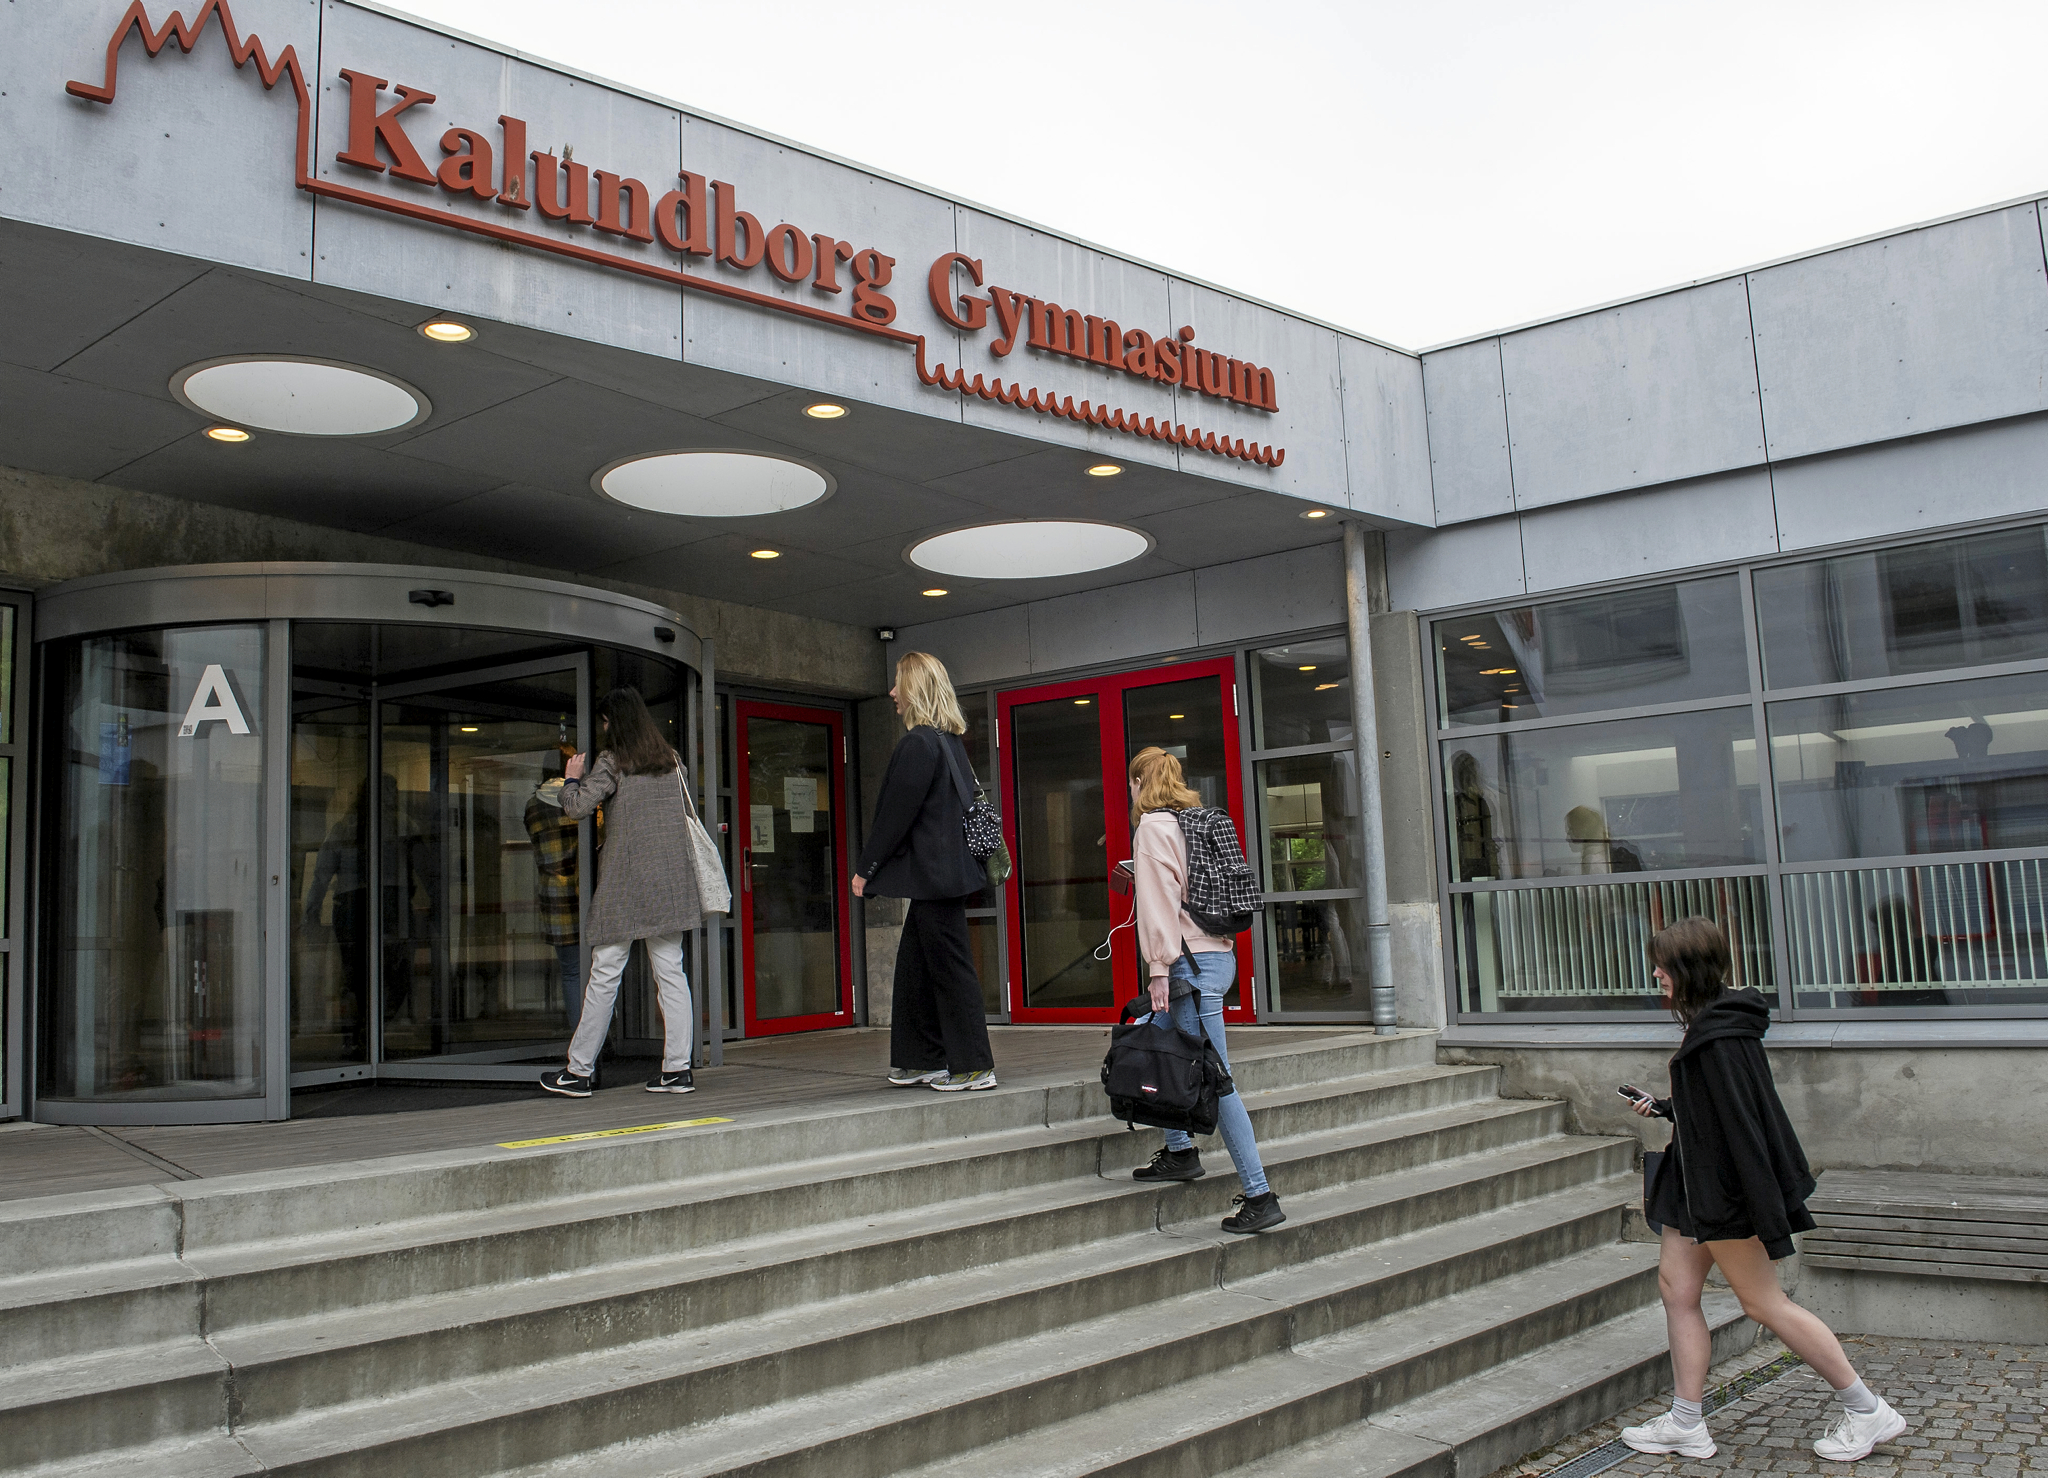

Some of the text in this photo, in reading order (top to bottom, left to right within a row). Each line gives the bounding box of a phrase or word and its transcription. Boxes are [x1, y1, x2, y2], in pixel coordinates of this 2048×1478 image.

[336, 67, 1280, 413] Kalundborg Gymnasium
[177, 664, 250, 737] A
